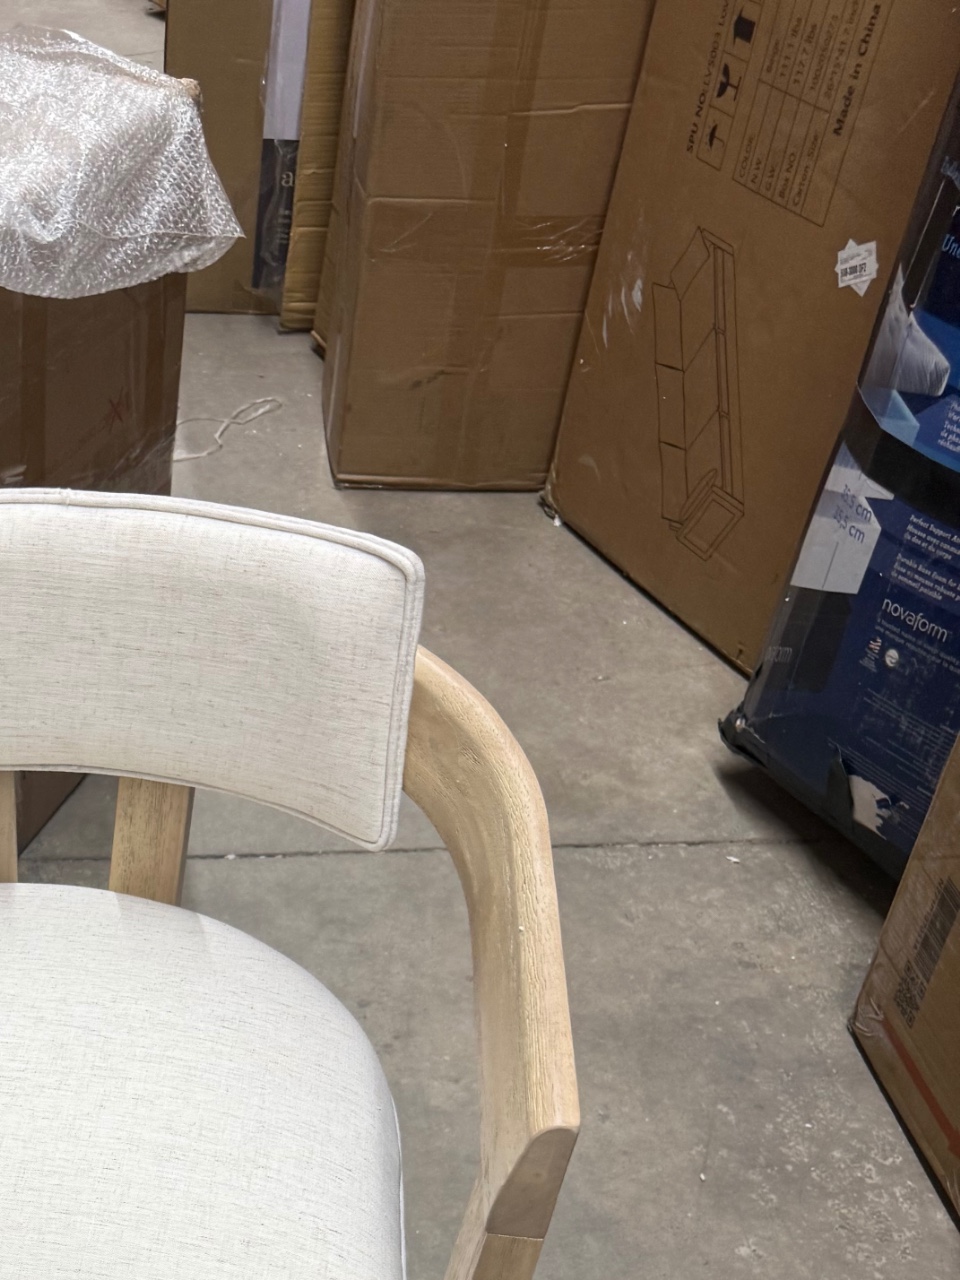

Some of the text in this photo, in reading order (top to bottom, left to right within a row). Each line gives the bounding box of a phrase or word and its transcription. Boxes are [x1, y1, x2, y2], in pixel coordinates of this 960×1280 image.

[833, 4, 881, 136] Made in China
[687, 122, 698, 153] SPU
[854, 504, 873, 523] cm
[848, 524, 865, 544] cm
[882, 598, 948, 643] novaform
